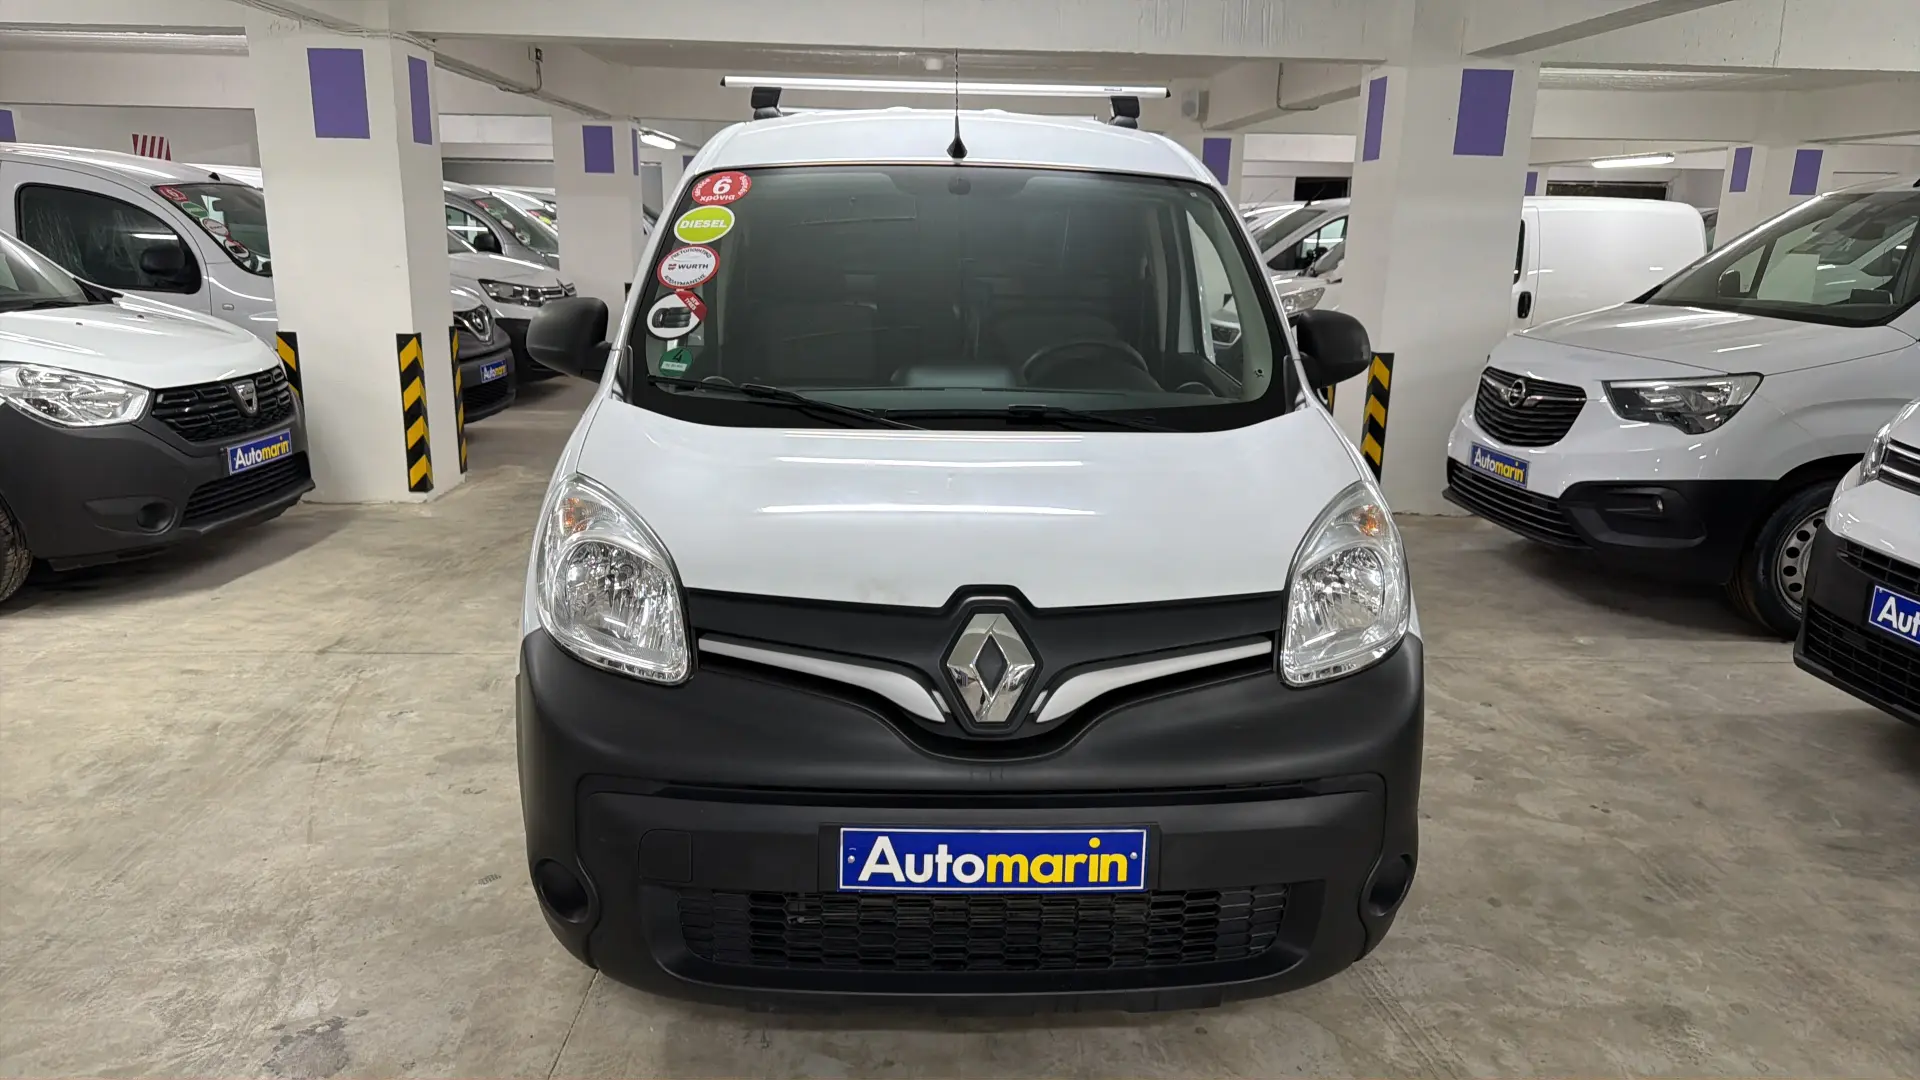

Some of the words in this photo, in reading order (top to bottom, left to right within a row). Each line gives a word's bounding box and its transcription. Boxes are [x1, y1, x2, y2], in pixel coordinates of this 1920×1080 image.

[700, 194, 736, 203] χρόνια
[713, 178, 732, 195] 6
[679, 219, 728, 229] DIESEL
[235, 436, 290, 469] Automarin
[1473, 447, 1524, 482] Automarin
[857, 835, 1128, 884] Automarin
